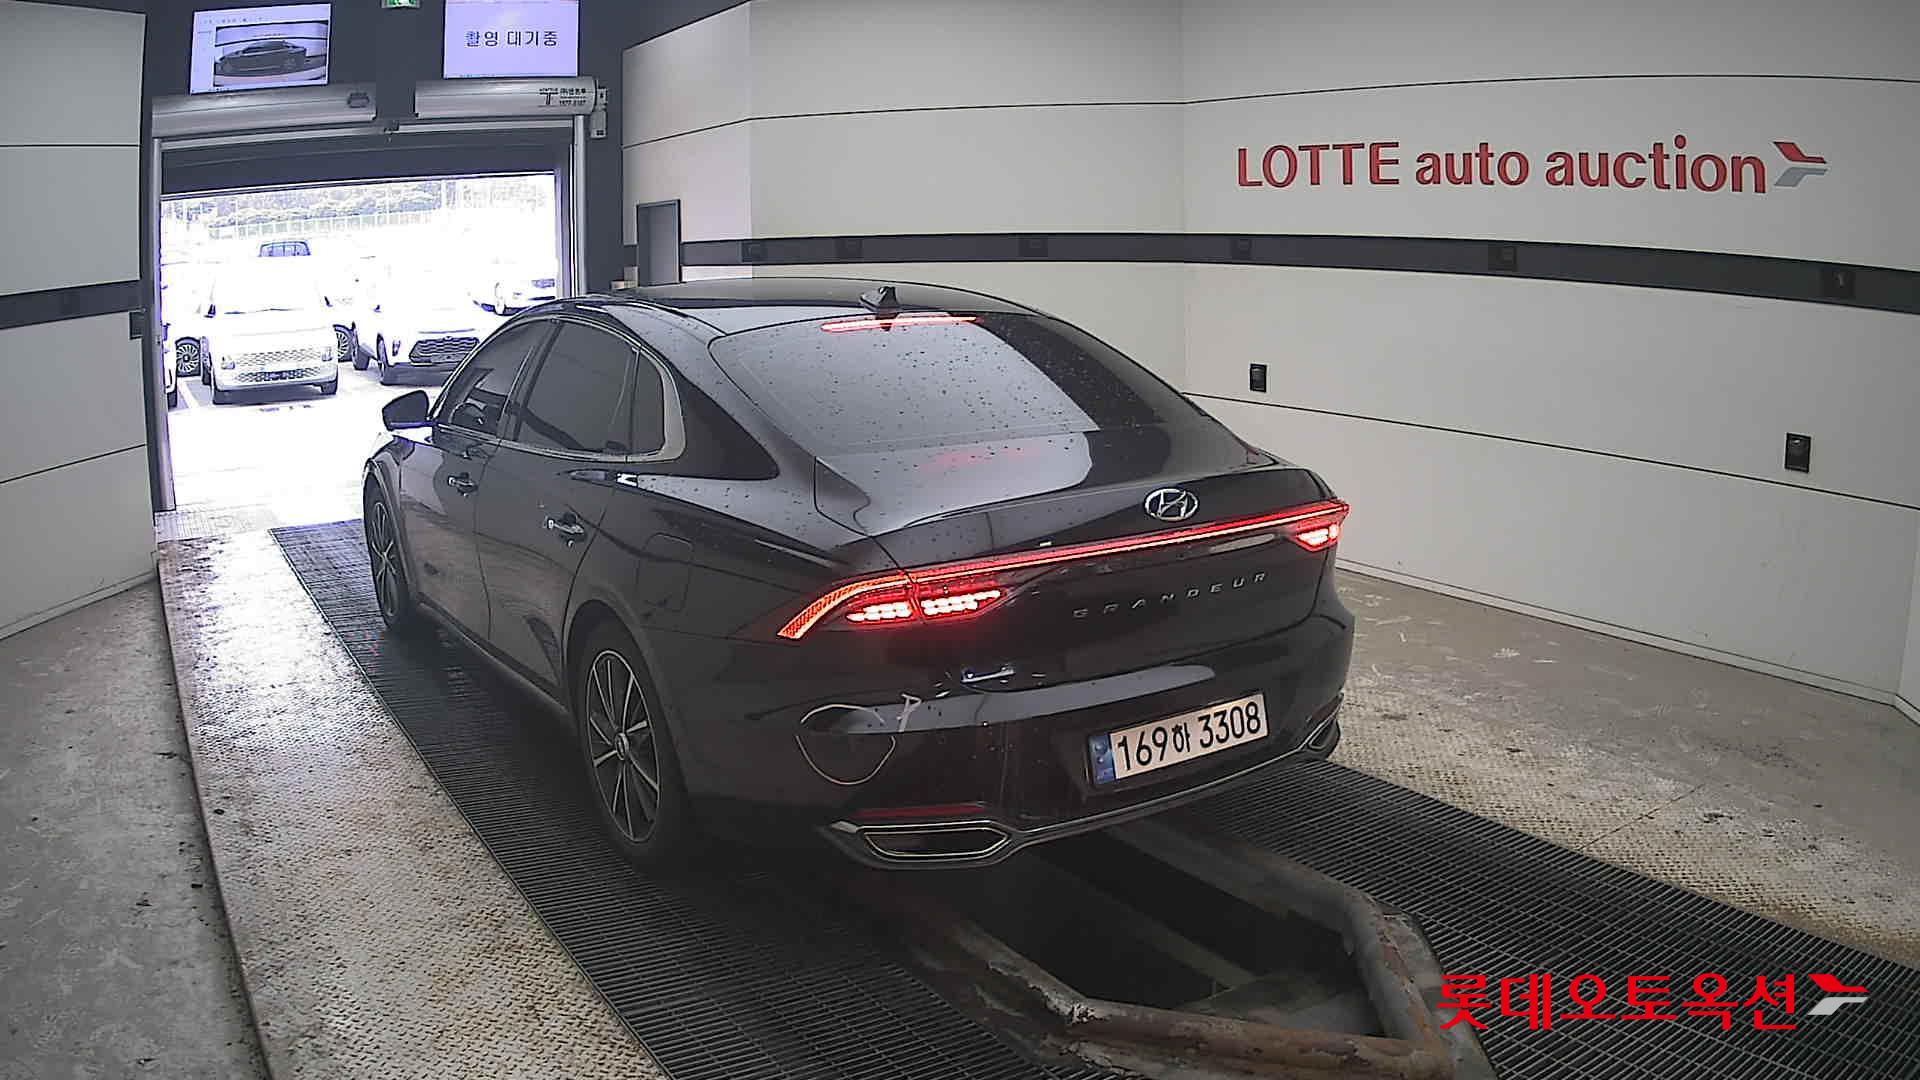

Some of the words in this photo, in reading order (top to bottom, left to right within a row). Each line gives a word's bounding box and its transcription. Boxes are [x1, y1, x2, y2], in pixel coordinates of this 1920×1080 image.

[506, 31, 559, 47] 대기중
[1238, 142, 1400, 188] LOTTE
[1415, 141, 1529, 187] auto
[1544, 134, 1767, 194] auction
[1072, 571, 1266, 619] GRANDEUR
[1117, 722, 1191, 771] 169하
[1198, 701, 1261, 748] 3308
